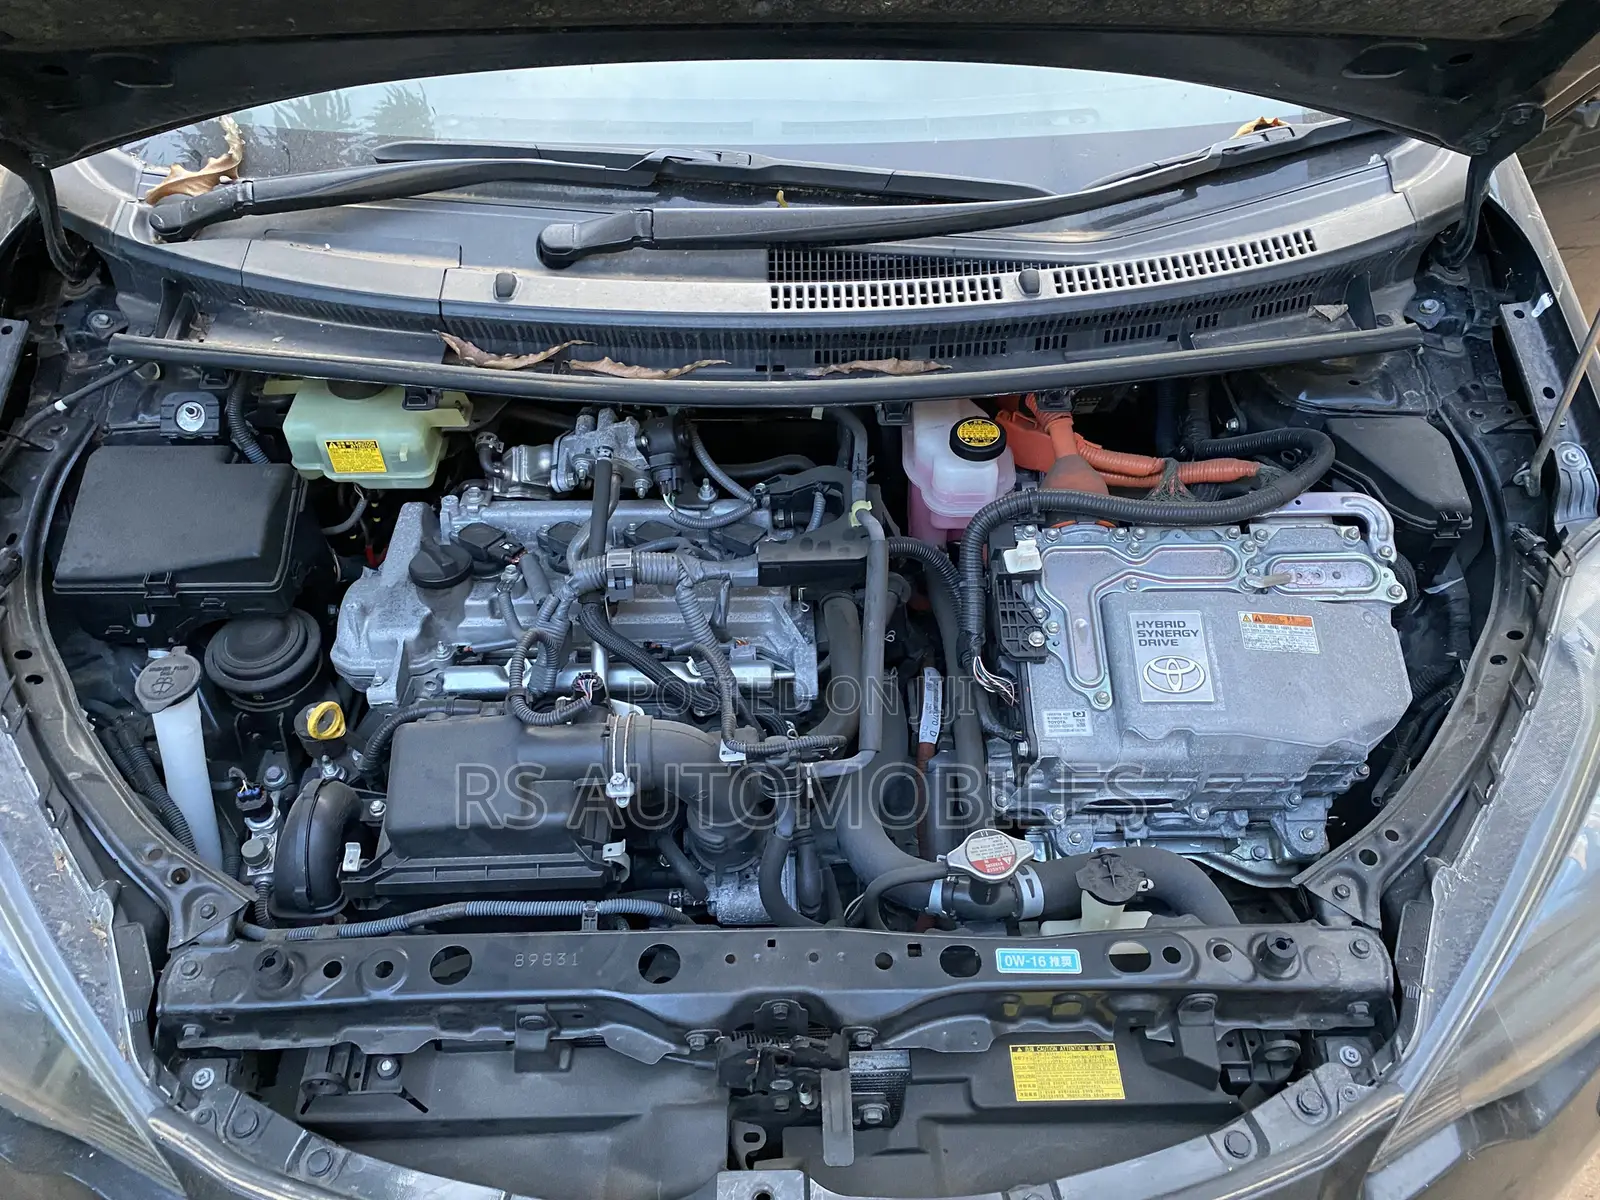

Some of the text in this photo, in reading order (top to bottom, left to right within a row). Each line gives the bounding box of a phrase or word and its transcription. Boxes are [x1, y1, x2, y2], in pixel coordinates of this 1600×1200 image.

[1136, 620, 1186, 628] HYBRID
[1137, 629, 1199, 638] SYNERGY
[1138, 638, 1179, 647] DRIVE
[514, 952, 579, 968] 89831
[1004, 955, 1047, 968] 0W-16
